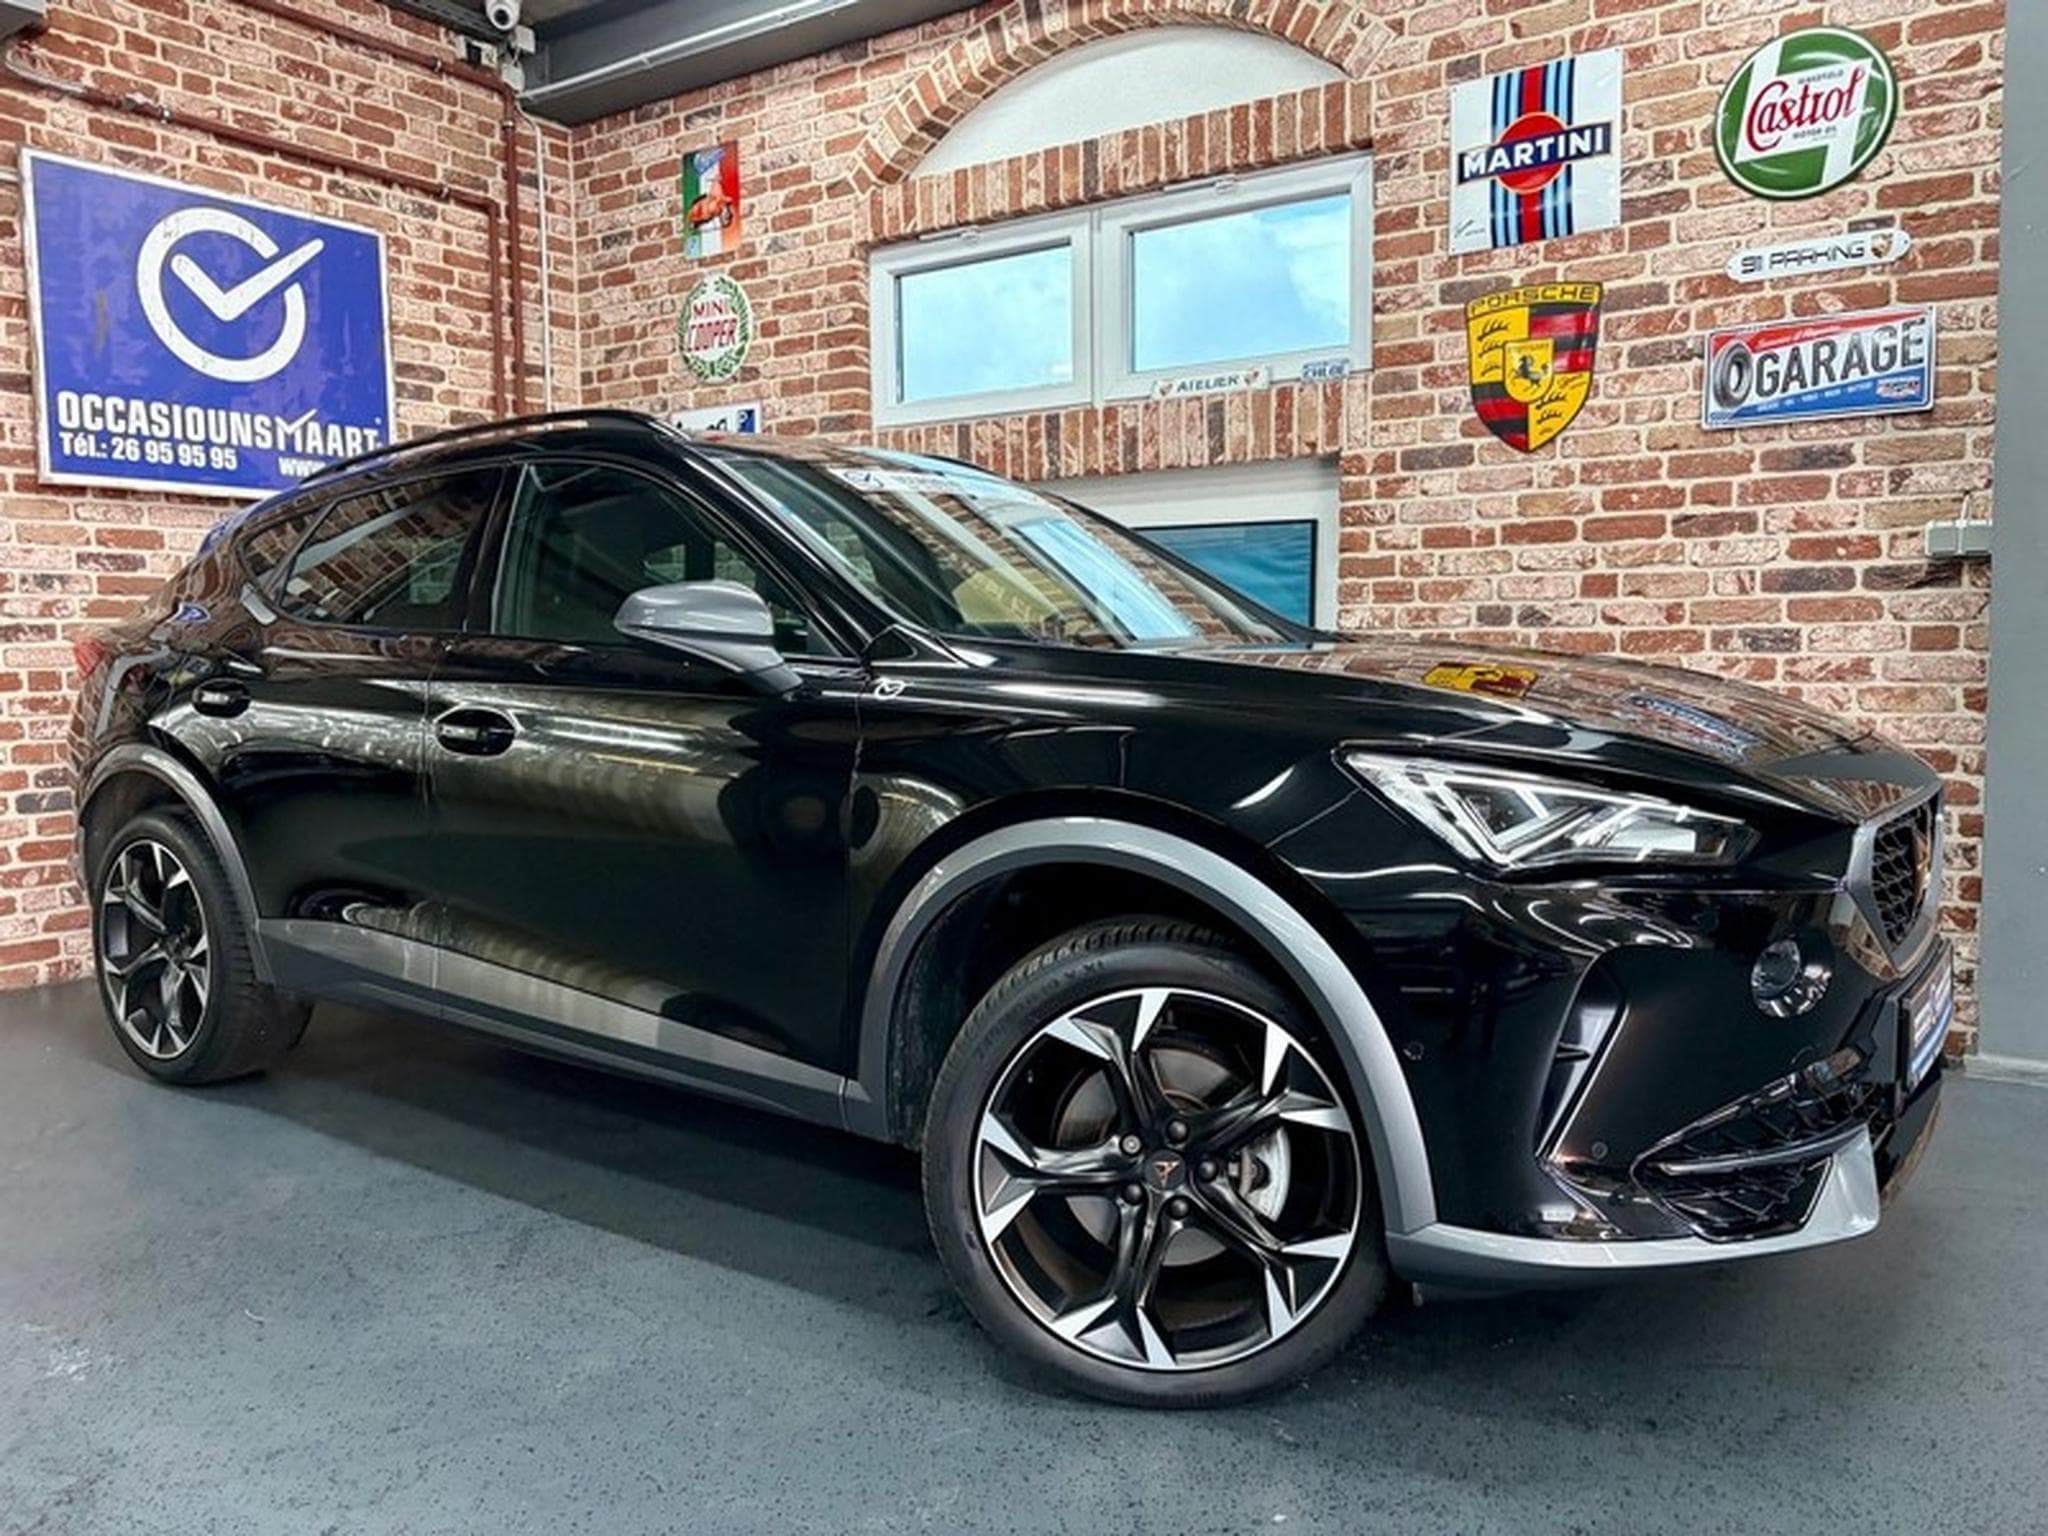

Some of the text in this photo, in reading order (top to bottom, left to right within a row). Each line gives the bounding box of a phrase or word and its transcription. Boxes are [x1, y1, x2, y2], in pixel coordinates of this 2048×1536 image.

[1747, 66, 1865, 152] Castrol
[1463, 127, 1604, 179] MARTINI
[1769, 240, 1864, 270] PARKING
[693, 299, 730, 318] MINI
[1471, 285, 1594, 316] PORSCHE
[688, 318, 737, 352] COOPER
[1755, 317, 1924, 398] GARAGE
[111, 436, 141, 462] 26
[145, 440, 174, 465] 95
[178, 443, 207, 469] 95
[210, 446, 238, 472] 95
